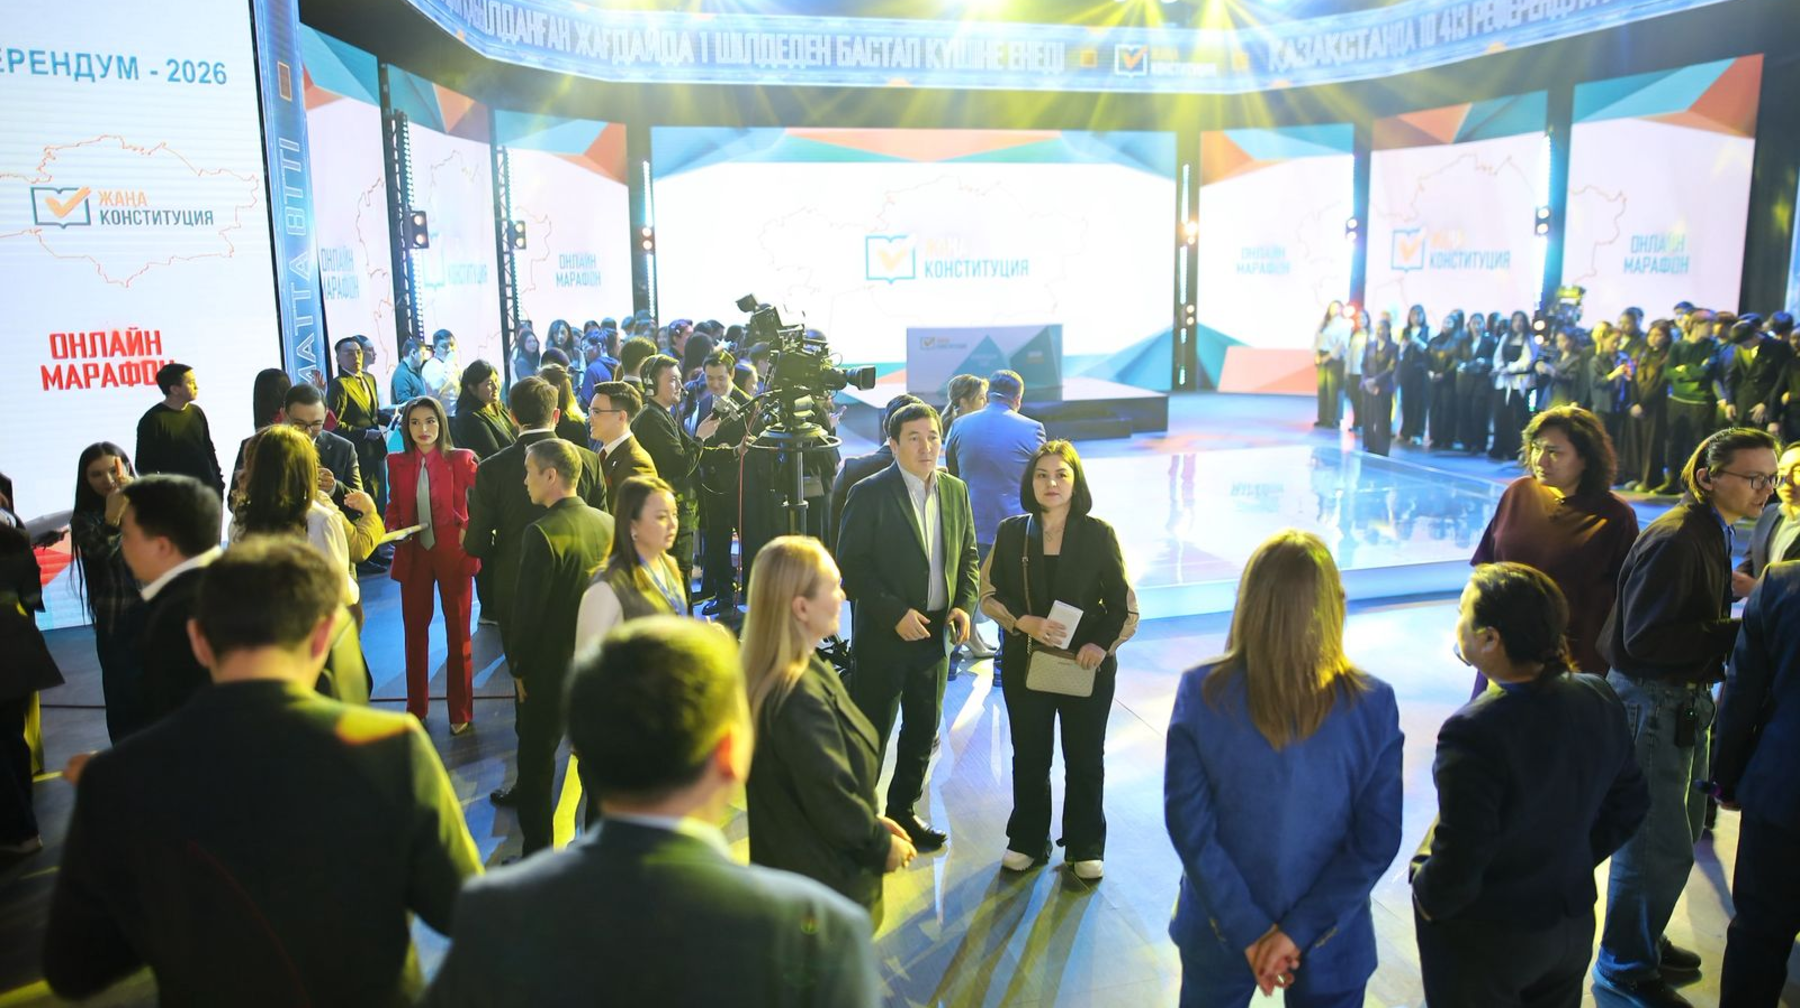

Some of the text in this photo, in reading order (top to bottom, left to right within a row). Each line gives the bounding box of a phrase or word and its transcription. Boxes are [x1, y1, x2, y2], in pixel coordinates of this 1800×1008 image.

[836, 35, 921, 68] БАСТАП
[166, 59, 227, 85] 2026
[100, 209, 214, 227] КОНСТИТУЦИЯ
[924, 258, 1030, 279] КОНСТИТУЦИЯ
[1623, 255, 1690, 275] МАРАФОН
[556, 270, 602, 288] МАРАФОН
[49, 327, 162, 359] ОНЛАЙН
[41, 360, 175, 391] МАРАФО
